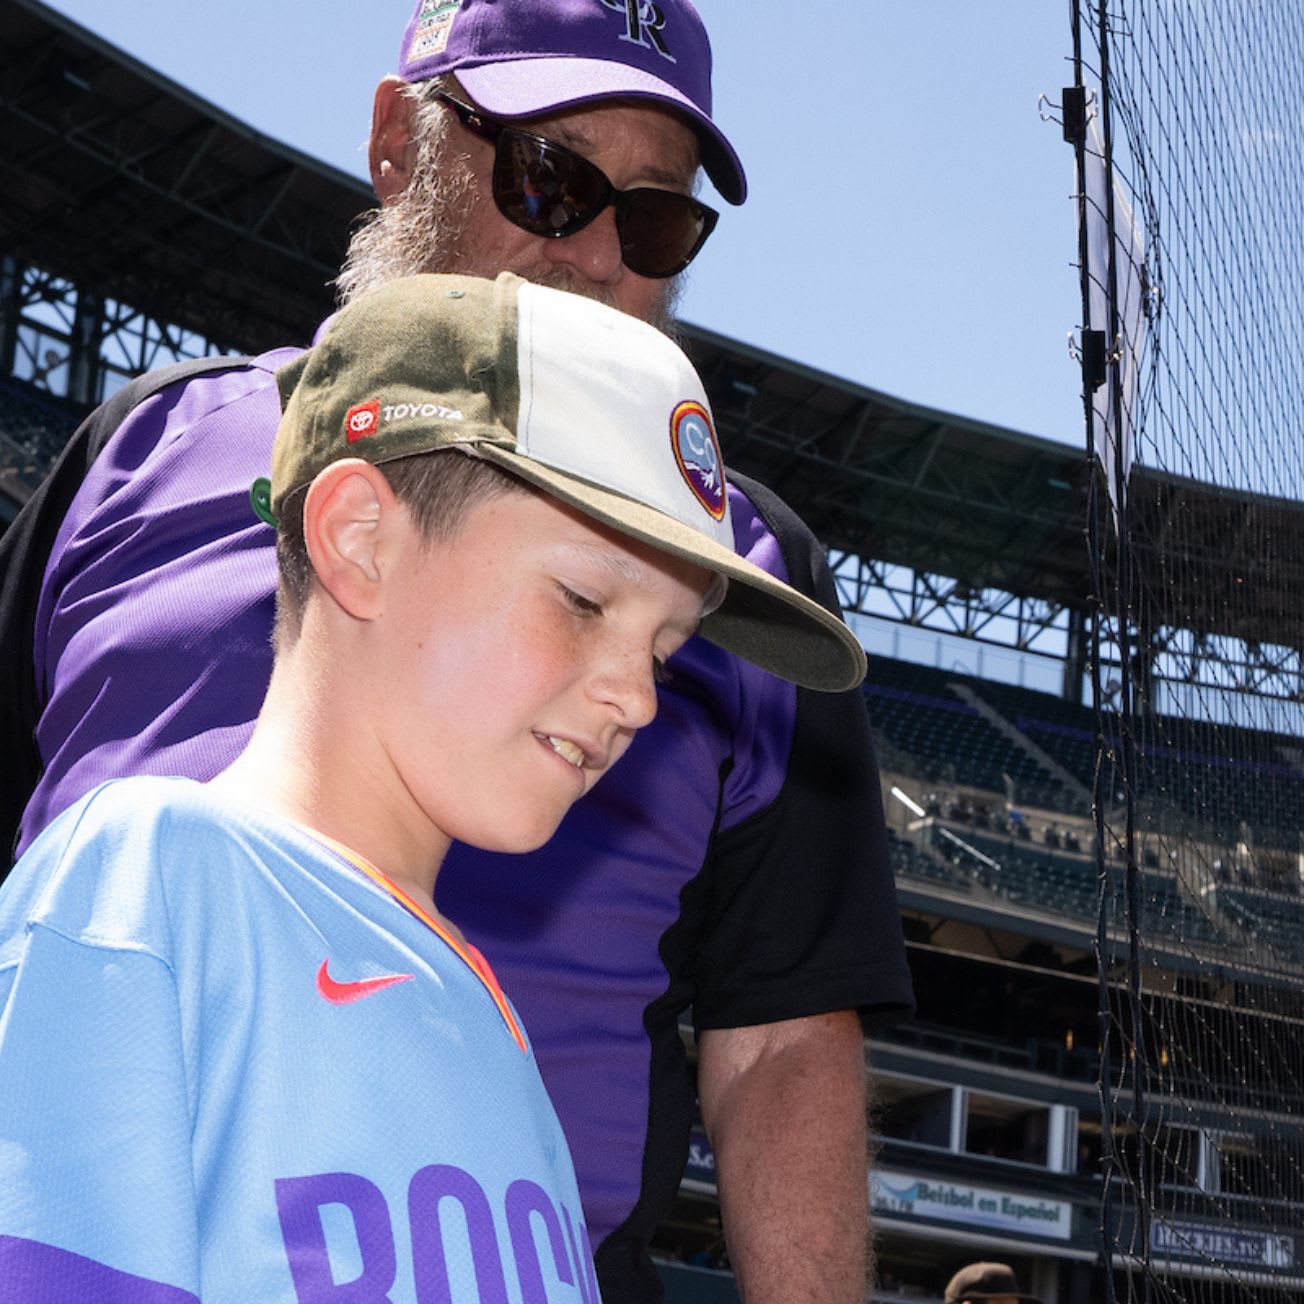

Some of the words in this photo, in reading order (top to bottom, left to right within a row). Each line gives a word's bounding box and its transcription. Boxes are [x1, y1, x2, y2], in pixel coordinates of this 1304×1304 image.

[382, 402, 464, 422] TOYOTA
[918, 1181, 975, 1208] Beisbol
[978, 1196, 997, 1212] en
